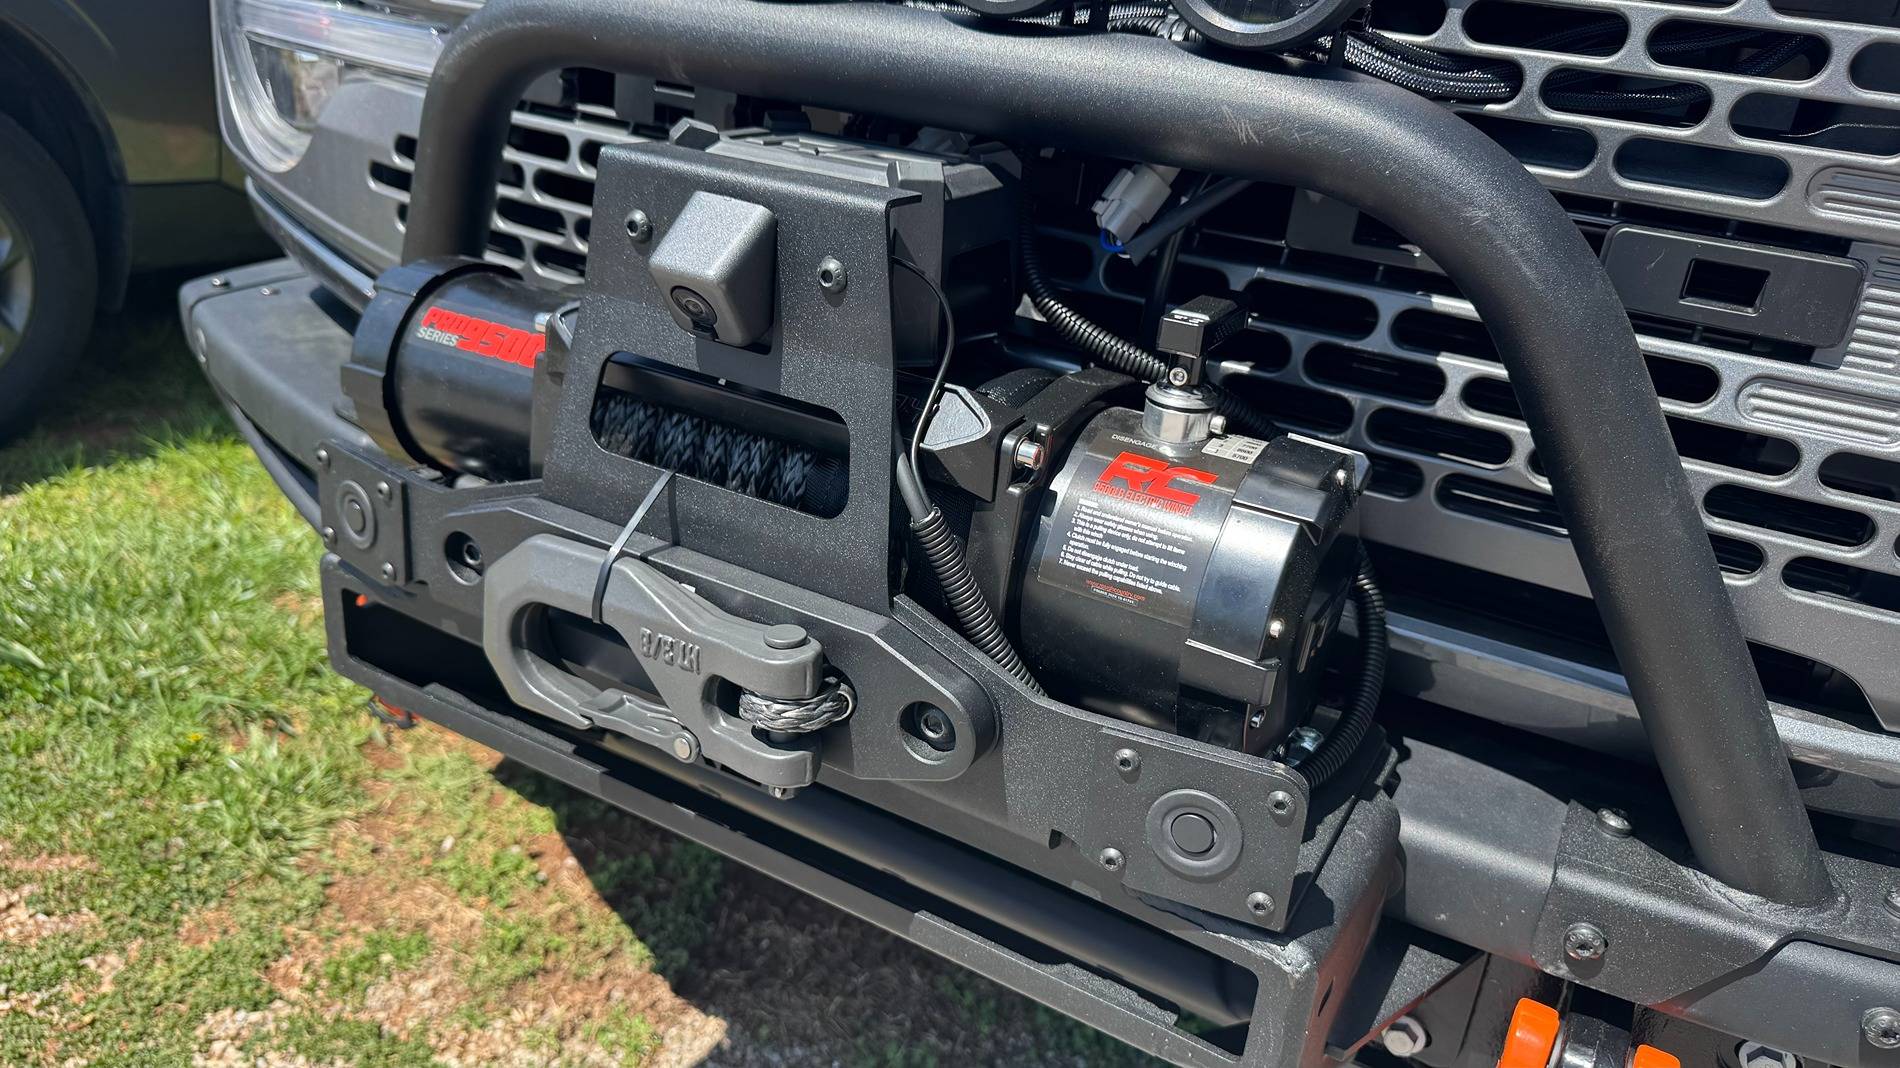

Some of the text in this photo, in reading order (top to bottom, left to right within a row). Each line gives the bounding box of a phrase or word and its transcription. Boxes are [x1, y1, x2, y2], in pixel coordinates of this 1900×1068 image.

[416, 327, 459, 347] SERIES
[1098, 451, 1219, 506] RC
[1162, 499, 1192, 517] WINCH
